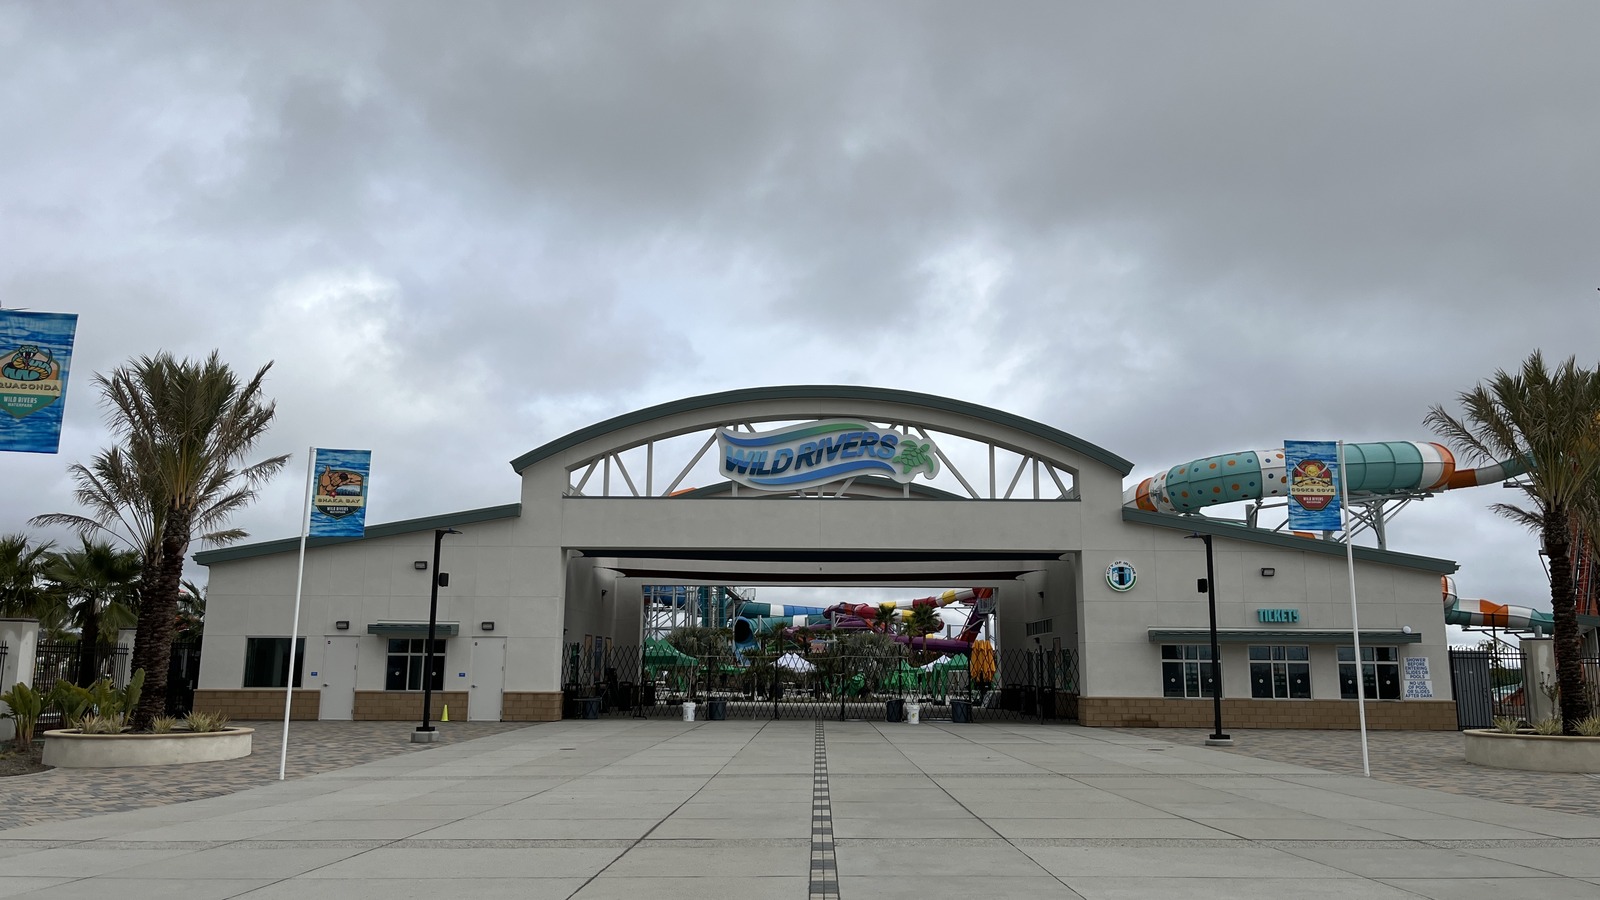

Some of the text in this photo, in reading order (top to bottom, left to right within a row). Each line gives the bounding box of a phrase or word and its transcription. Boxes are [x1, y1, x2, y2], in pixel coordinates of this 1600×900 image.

[0, 382, 60, 391] QUACONDA
[725, 431, 899, 476] WILD RIVERS
[1257, 608, 1300, 623] TICKETS
